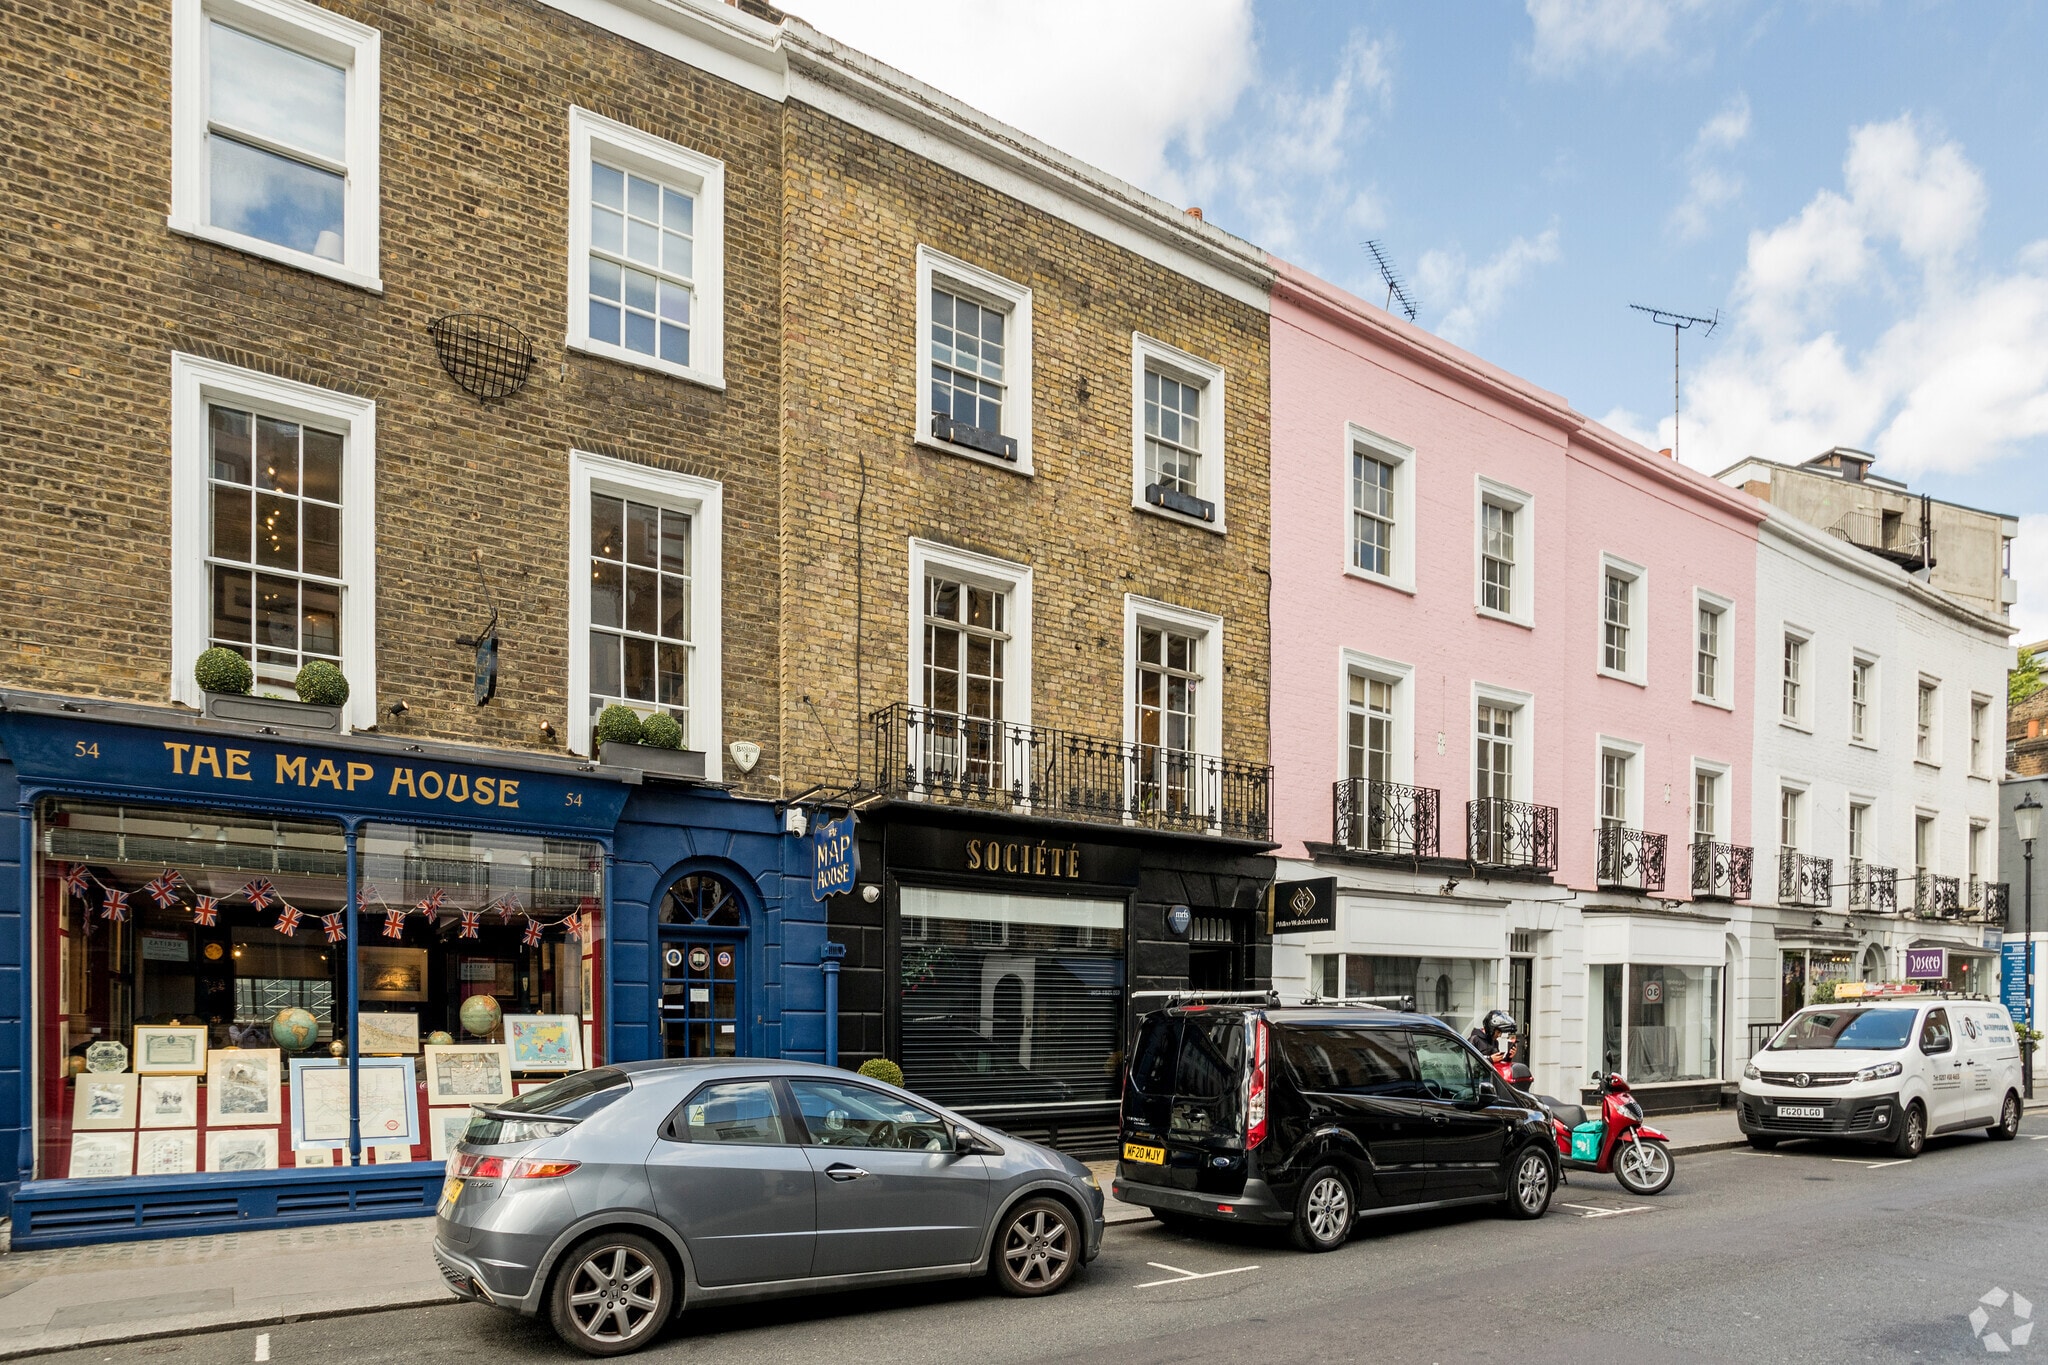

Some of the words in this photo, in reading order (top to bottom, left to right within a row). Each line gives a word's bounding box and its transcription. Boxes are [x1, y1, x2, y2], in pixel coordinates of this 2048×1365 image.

[75, 741, 100, 758] 54
[163, 741, 253, 781] THE
[275, 754, 374, 791] MAP
[388, 767, 520, 809] HOUSE
[565, 792, 583, 807] 54
[818, 835, 850, 869] MAP
[966, 839, 1079, 878] SOCIÉTÉ
[817, 863, 849, 890] HOUSE
[1310, 917, 1329, 925] London
[1910, 954, 1941, 973] JOSEPH
[1780, 1107, 1802, 1116] FG20
[1127, 1145, 1145, 1159] MF20
[1145, 1148, 1161, 1161] MJY
